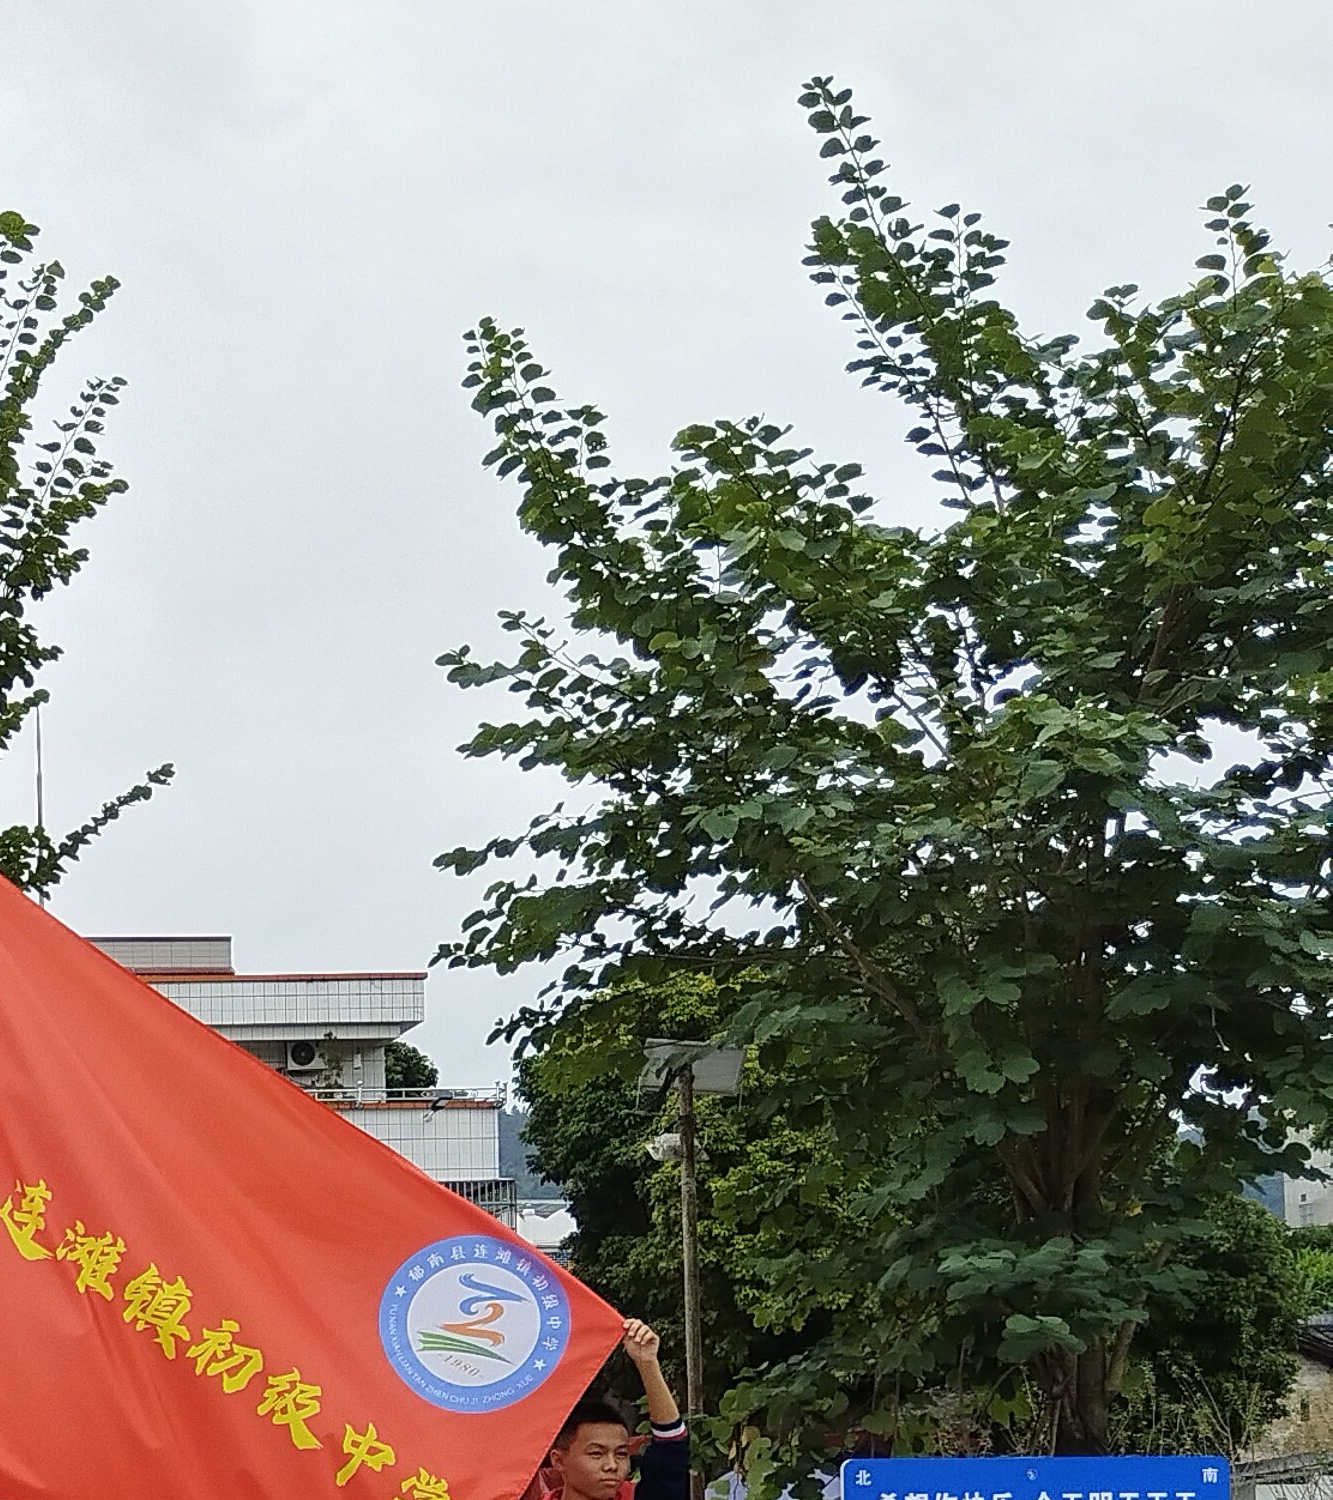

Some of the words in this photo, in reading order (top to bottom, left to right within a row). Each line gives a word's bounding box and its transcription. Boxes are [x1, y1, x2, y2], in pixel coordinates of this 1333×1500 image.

[408, 1244, 562, 1351] 郁南县连滩镇初级中学
[855, 1470, 872, 1486] 北
[1202, 1467, 1219, 1484] 南
